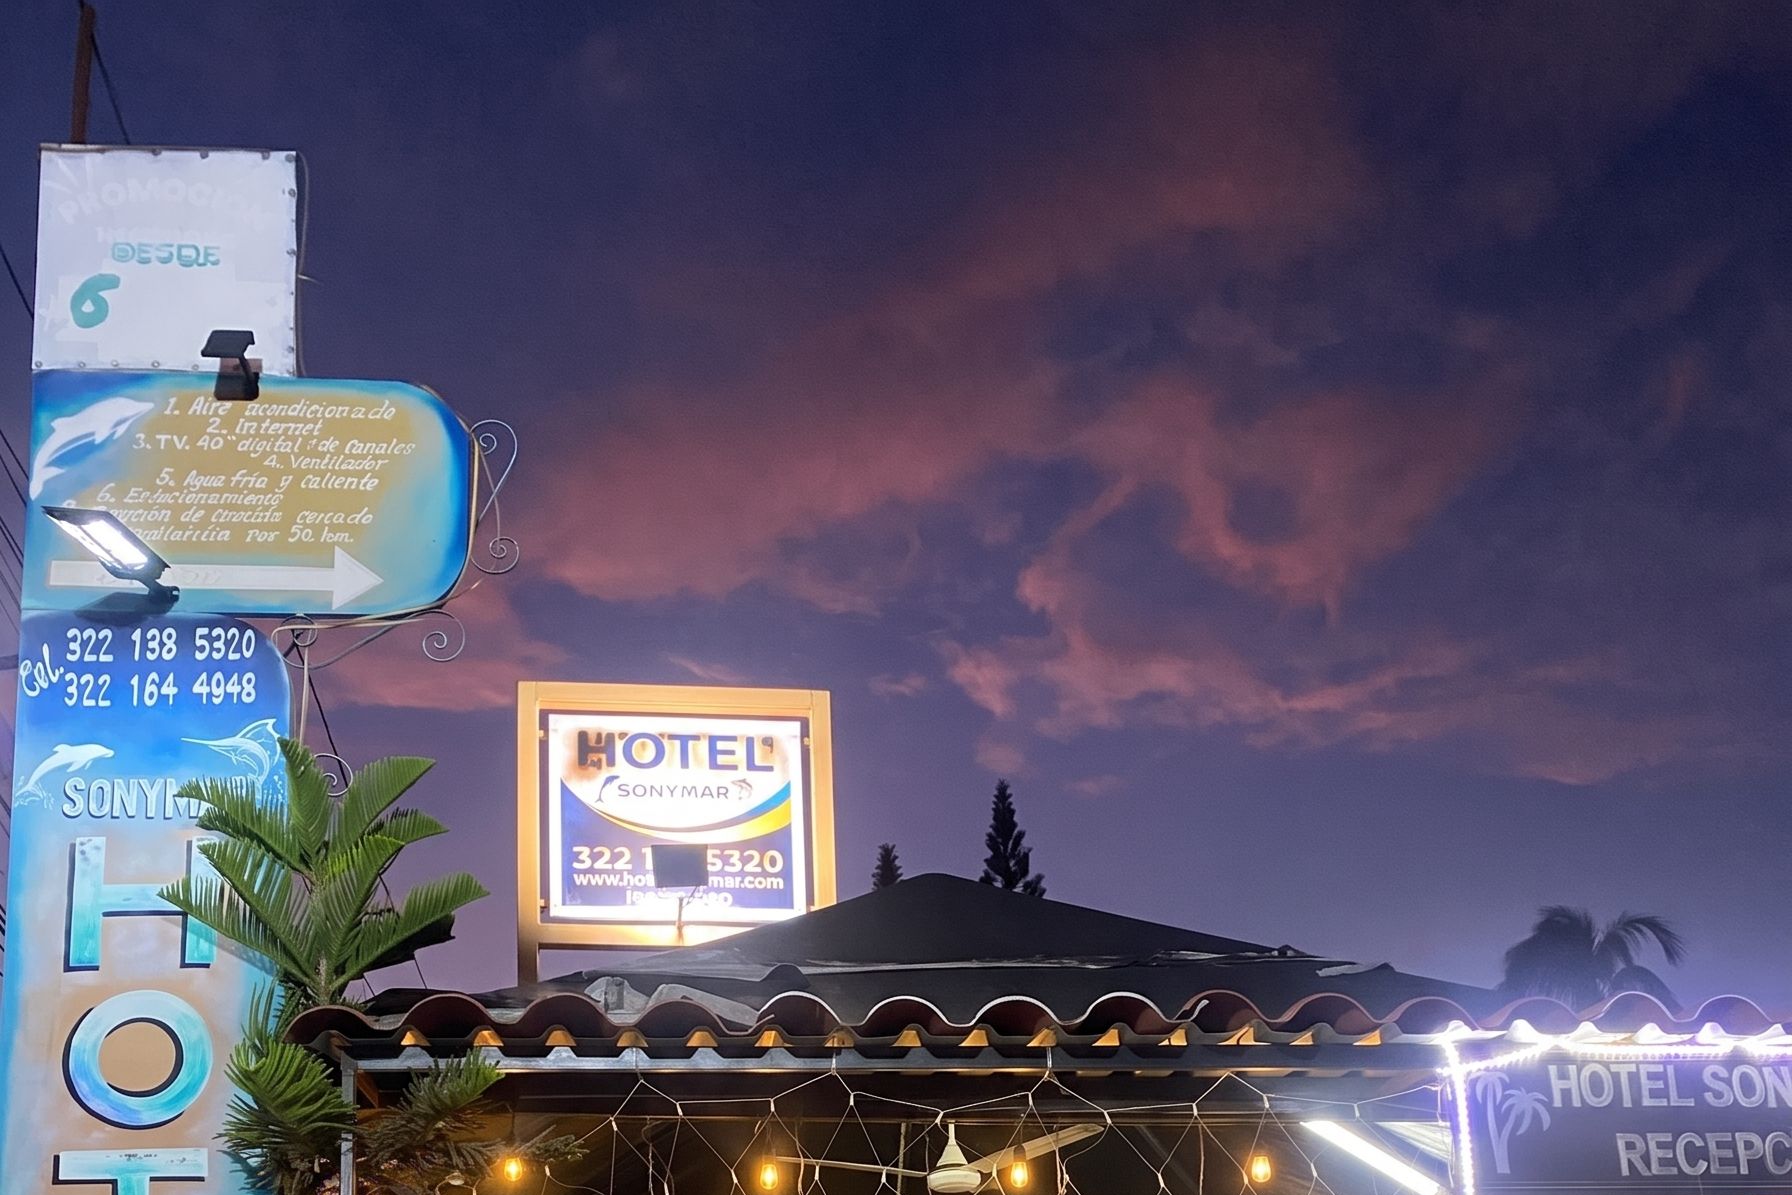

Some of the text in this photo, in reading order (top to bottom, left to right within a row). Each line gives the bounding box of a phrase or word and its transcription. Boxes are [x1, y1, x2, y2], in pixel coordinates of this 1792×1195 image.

[70, 272, 121, 329] 6
[163, 396, 181, 416] 1.
[187, 396, 233, 417] Aire
[206, 416, 323, 436] 2. Internet
[132, 433, 152, 450] 3.
[155, 434, 191, 451] TV.
[289, 453, 390, 471] Ventilador
[155, 467, 176, 487] 5.
[183, 469, 227, 492] Agua
[95, 483, 116, 503] 6.
[66, 627, 114, 662] 322
[130, 627, 178, 661] 138
[194, 627, 257, 661] 5320
[64, 671, 257, 707] 322 164 4948
[577, 730, 774, 772] HOTEL
[62, 776, 214, 821] SONYM
[617, 783, 729, 800] SONYMAR
[571, 845, 633, 870] 322
[706, 848, 784, 872] 5320
[1548, 1064, 1696, 1108] HOTEL
